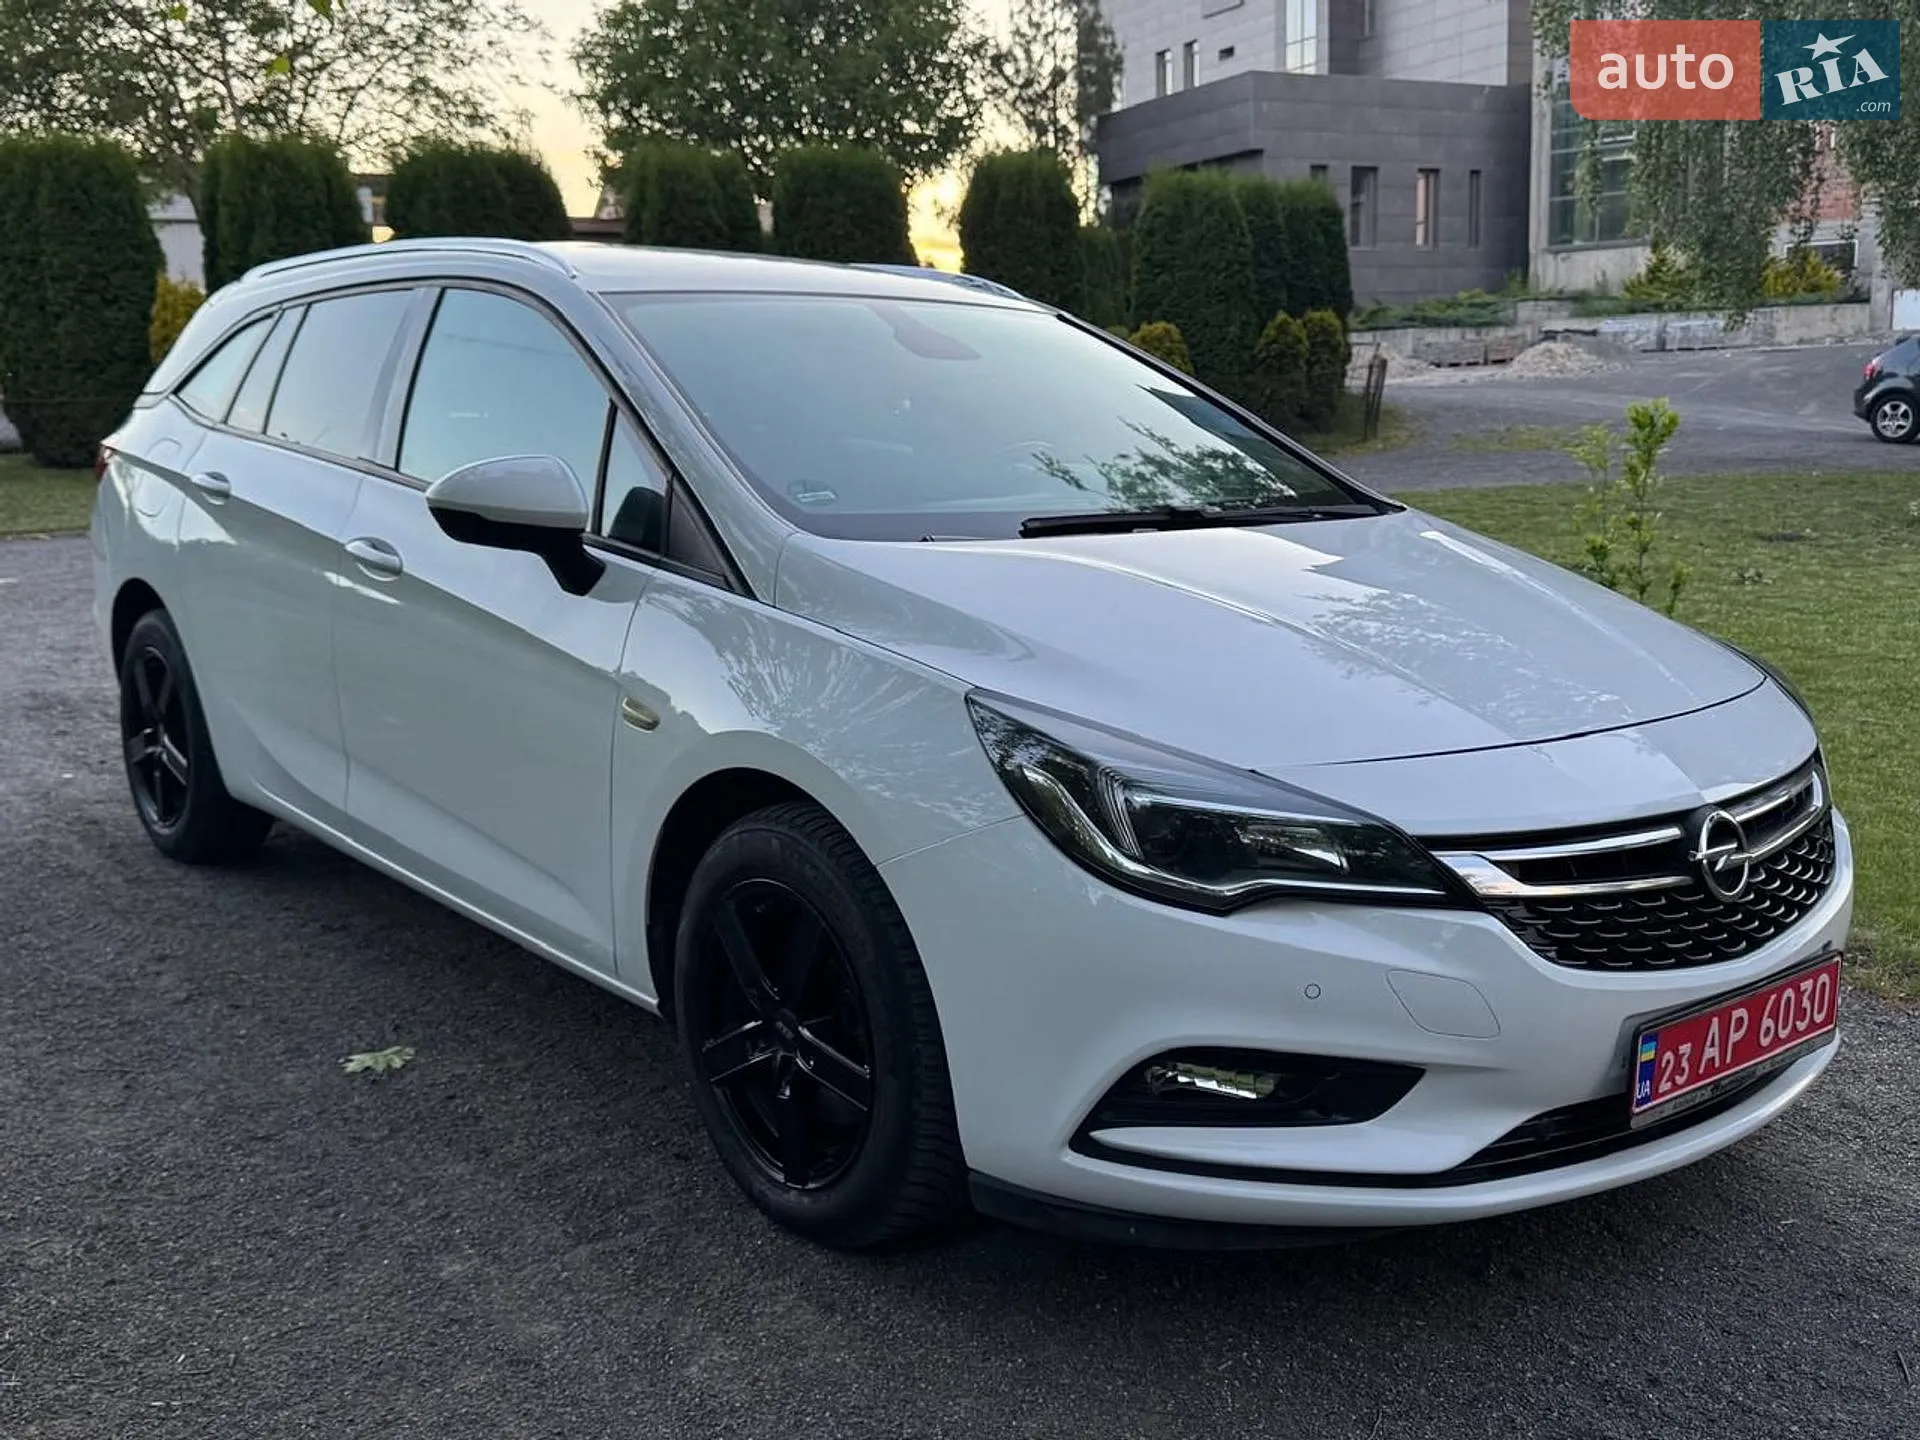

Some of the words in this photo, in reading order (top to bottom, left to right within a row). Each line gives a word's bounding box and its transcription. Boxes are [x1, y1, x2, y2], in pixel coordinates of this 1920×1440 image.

[1658, 1043, 1691, 1093] 23
[1698, 1008, 1748, 1074] AP
[1759, 973, 1830, 1047] 6030
[1636, 1080, 1650, 1099] UA
